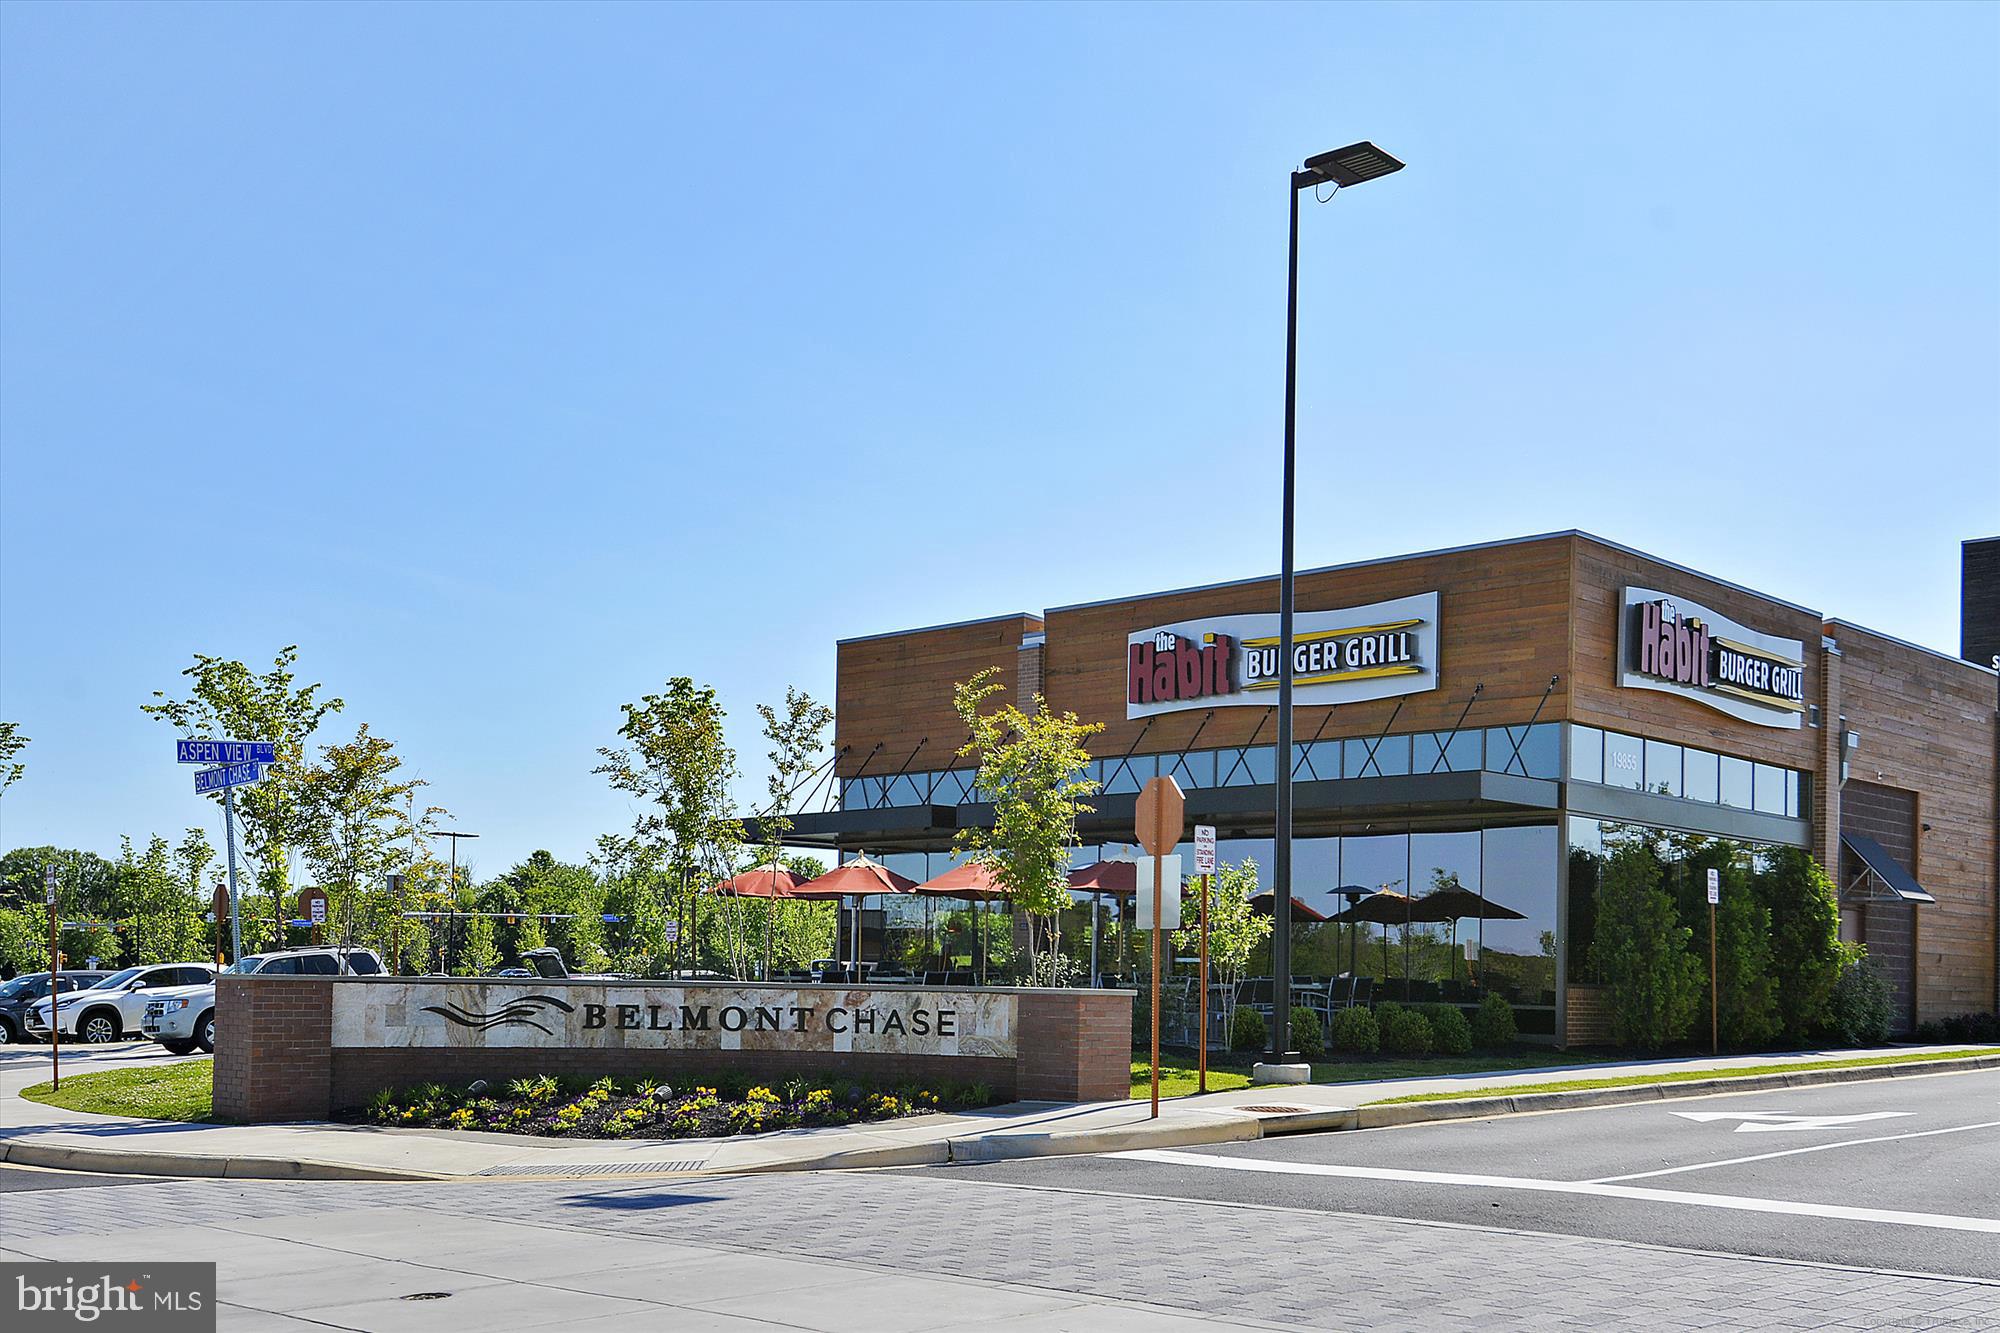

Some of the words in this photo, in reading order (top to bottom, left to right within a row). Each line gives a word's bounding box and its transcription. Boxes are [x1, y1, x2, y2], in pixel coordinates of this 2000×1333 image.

[1662, 600, 1676, 624] the
[1155, 631, 1176, 653] the
[1641, 601, 1710, 688] Habit
[1719, 650, 1769, 691] BURGER
[1772, 666, 1804, 700] GRILL
[1129, 633, 1231, 704] Habit
[1247, 643, 1338, 679] BUGER
[1345, 632, 1411, 668] GRILL
[179, 743, 220, 761] ASPEN
[224, 743, 252, 761] VIEW
[256, 744, 273, 754] BLVD
[195, 768, 226, 791] BELMONT
[228, 763, 251, 785] CHASE
[1196, 836, 1214, 844] PARKING
[582, 1003, 816, 1033] BELMONT
[825, 1007, 957, 1037] CHASE
